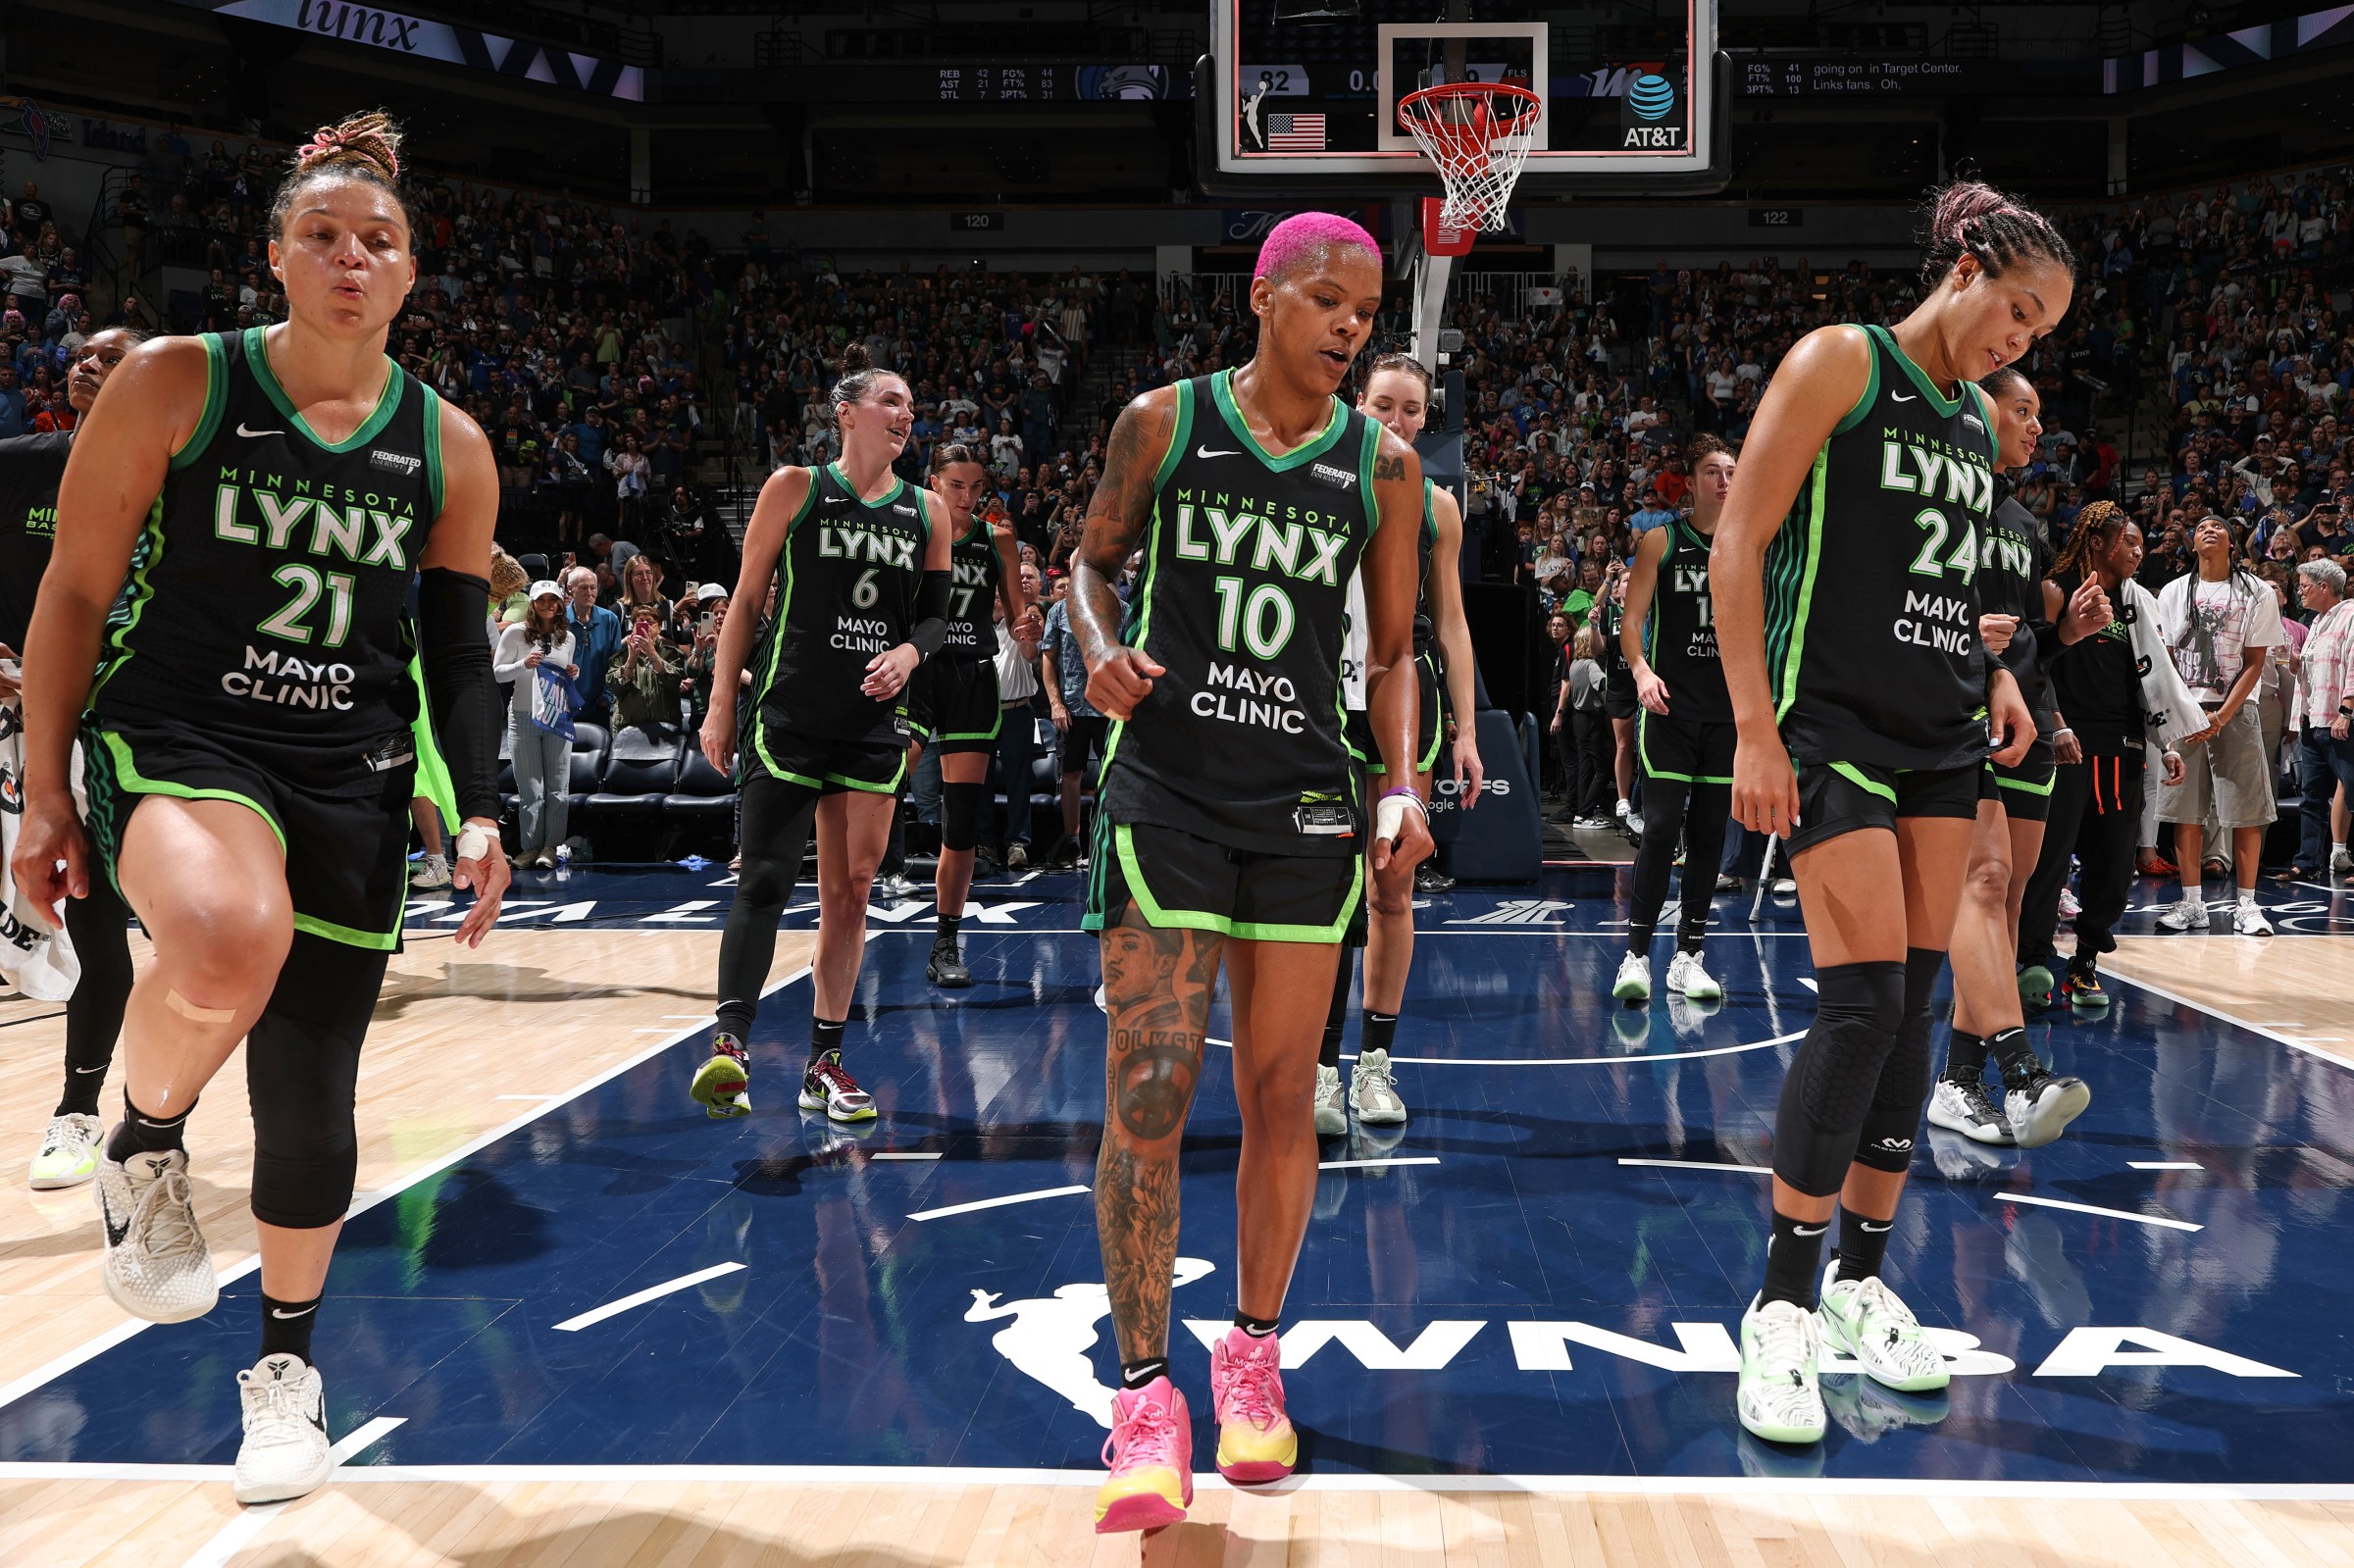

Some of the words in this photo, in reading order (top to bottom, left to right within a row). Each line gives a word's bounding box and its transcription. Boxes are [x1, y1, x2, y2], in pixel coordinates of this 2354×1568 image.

[297, 0, 420, 51] lynx
[940, 70, 960, 78] REB
[977, 69, 989, 78] 42
[1002, 70, 1025, 78] FG%
[1041, 69, 1052, 77] 44
[1260, 70, 1290, 91] 82
[1508, 69, 1527, 77] FLS
[1747, 64, 1770, 73] FG%
[1747, 74, 1769, 82] FT%
[1784, 75, 1802, 83] 100
[1814, 64, 1846, 76] going
[1848, 66, 1863, 75] on
[1869, 64, 1879, 74] in
[1882, 63, 1919, 76] Target
[1921, 63, 1963, 75] Center.
[940, 80, 959, 89] AST
[978, 79, 989, 88] 21
[1002, 79, 1024, 88] FT%
[1041, 79, 1052, 88] 83
[941, 90, 959, 99] STL
[981, 90, 986, 99] 7
[1000, 90, 1027, 99] 3PT%
[1043, 89, 1052, 99] 31
[1746, 84, 1773, 94] 3PT%
[1788, 85, 1800, 94] 13
[1813, 78, 1843, 90] Links
[1846, 78, 1873, 90] fans.
[1880, 78, 1902, 91] Oh,
[82, 119, 148, 154] Island
[1624, 127, 1680, 147] AT&T
[964, 214, 990, 228] 120
[1763, 211, 1789, 225] 122
[2071, 349, 2091, 359] LYNX
[371, 450, 422, 468] FEDERATED
[1884, 427, 1991, 471] MINNESOTA
[1312, 463, 1356, 482] FEDERATED
[1880, 440, 1994, 520] LYNX
[220, 466, 414, 517] MINNESOTA
[1177, 488, 1351, 535] MINNESOTA
[215, 483, 413, 571] LYNX
[820, 518, 917, 541] MINNESOTA
[818, 527, 917, 572] LYNX
[1176, 504, 1349, 586] LYNX
[1909, 507, 1977, 586] 24
[851, 568, 881, 610] 6
[1674, 570, 1713, 592] LY
[256, 563, 356, 647] 21
[1214, 576, 1296, 661] 10
[1696, 595, 1715, 628] 1
[1904, 589, 1970, 628] MAYO
[838, 616, 888, 636] MAYO
[1893, 619, 1970, 656] CLINIC
[829, 633, 891, 654] CLINIC
[243, 644, 356, 684] MAYO
[221, 672, 355, 711] CLINIC
[1206, 661, 1296, 702] MAYO
[1190, 691, 1305, 734] CLINIC
[0, 900, 41, 951] DE
[636, 900, 1045, 923] LNX
